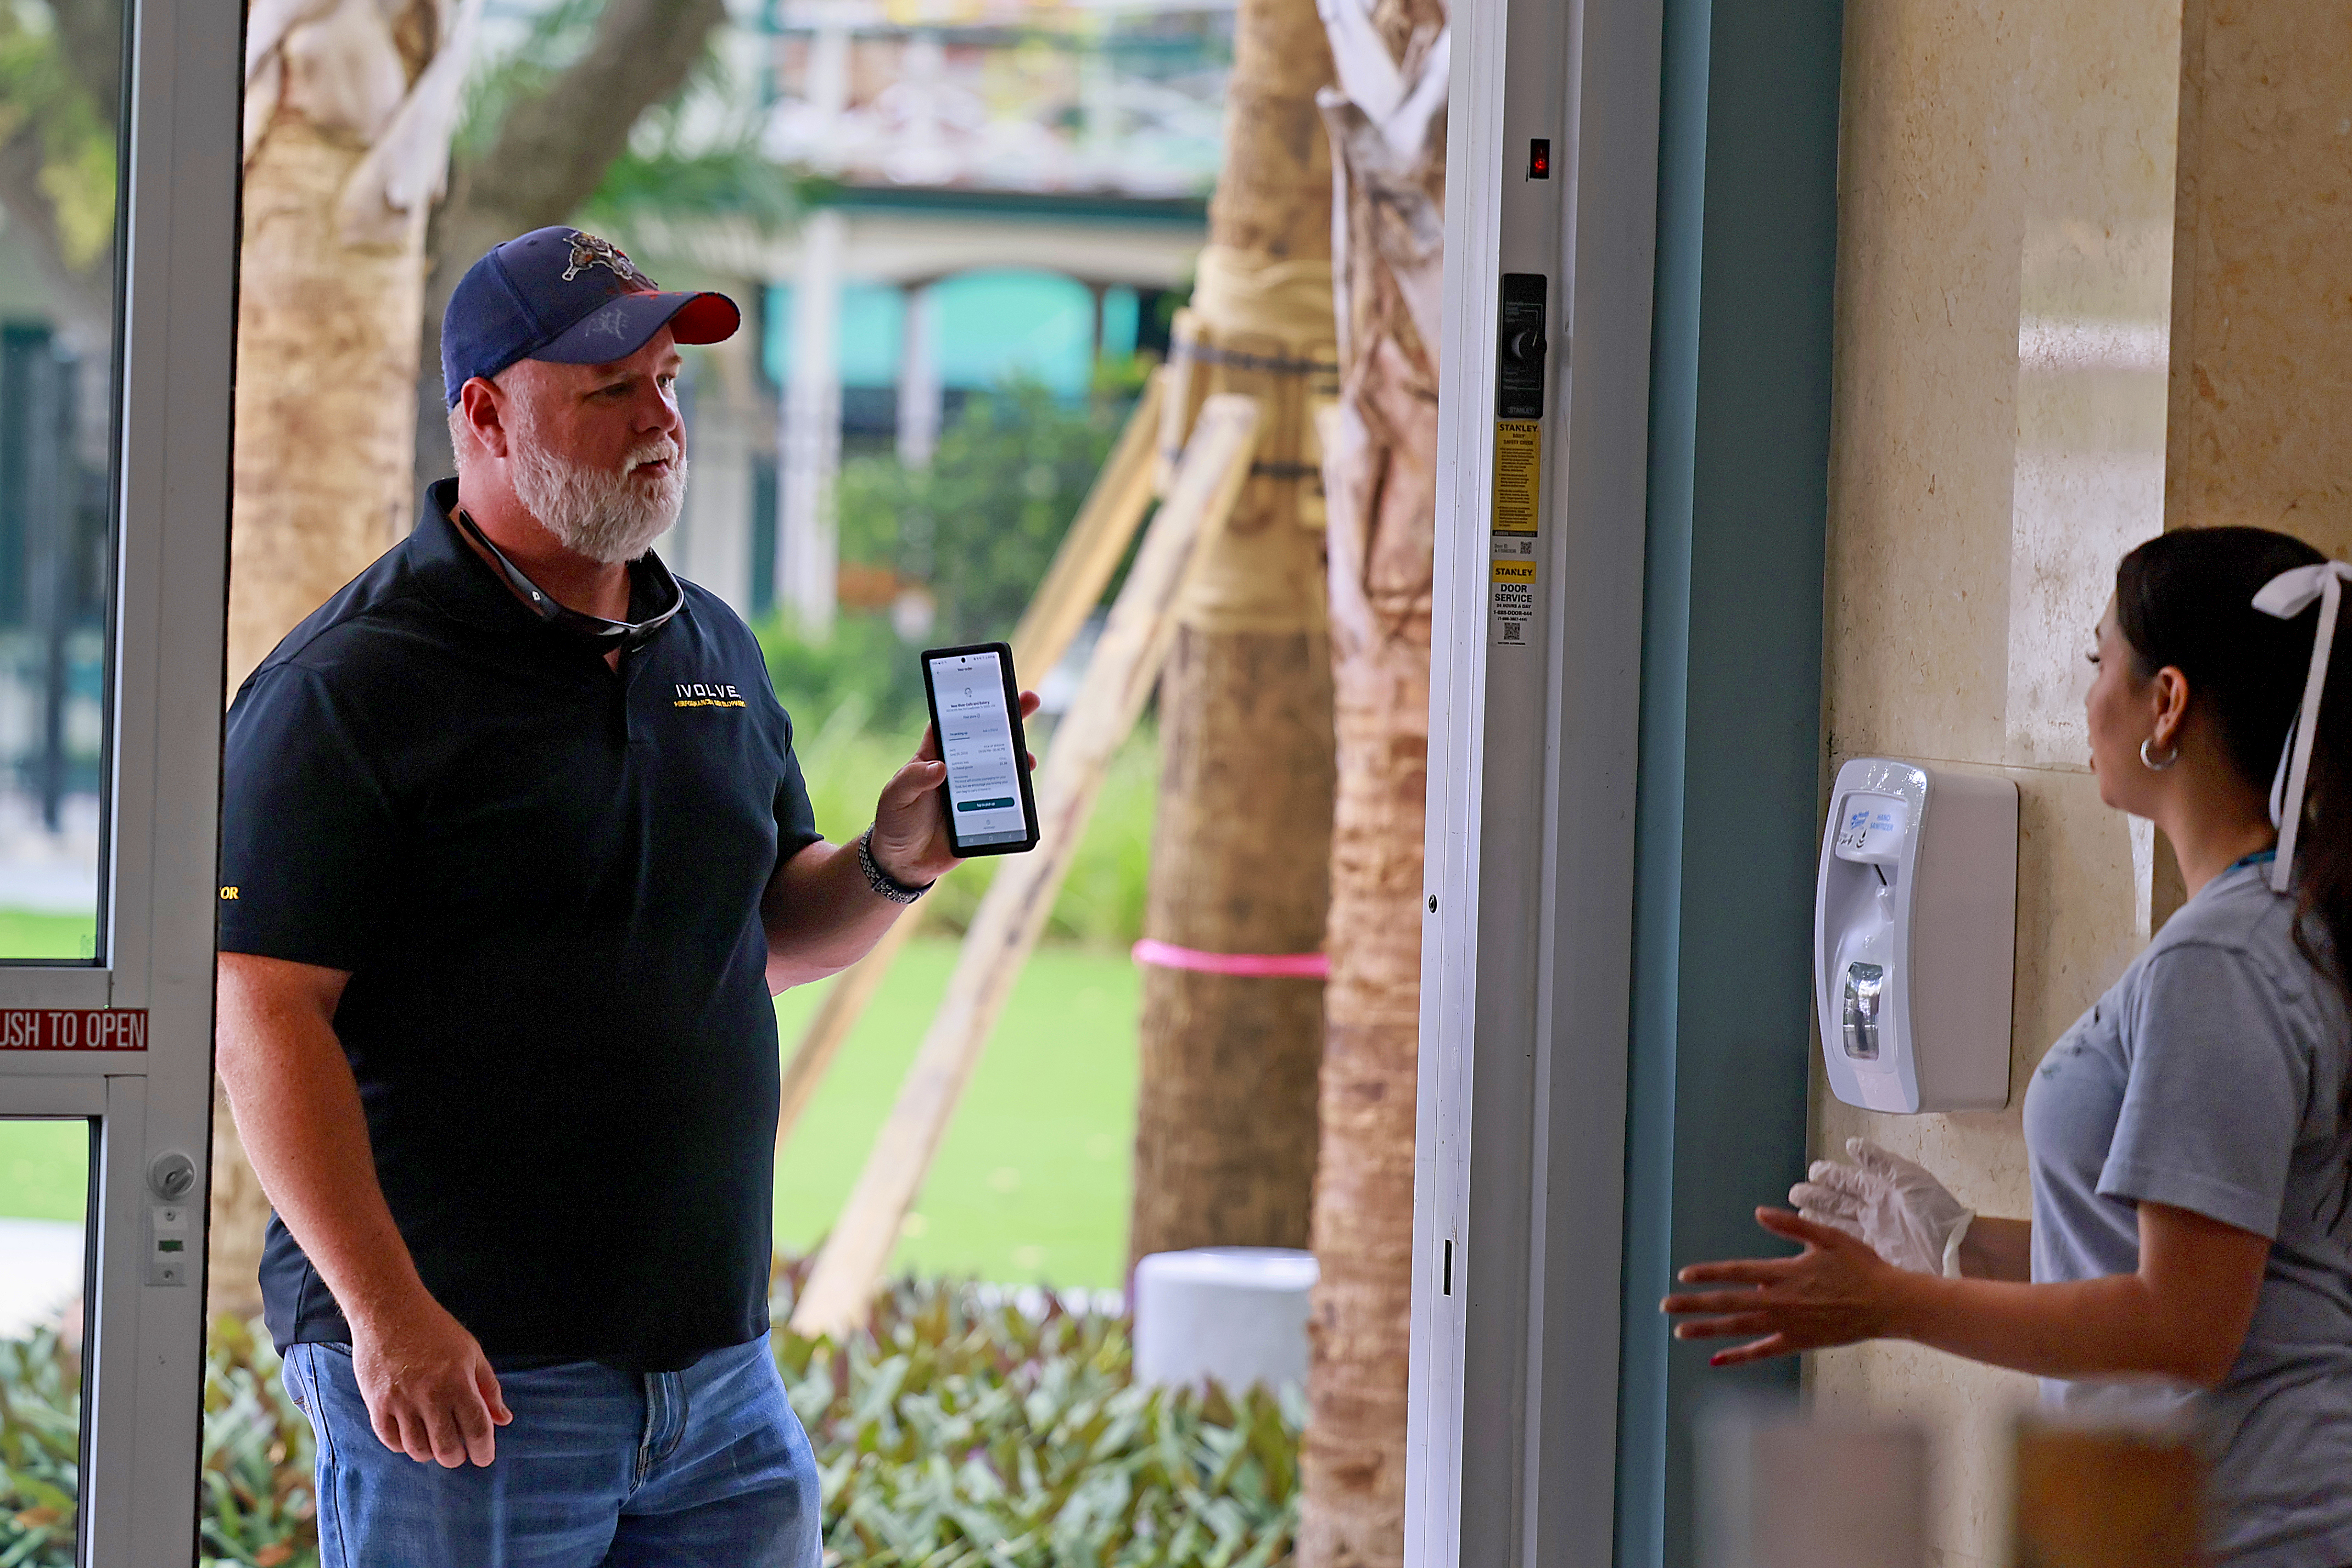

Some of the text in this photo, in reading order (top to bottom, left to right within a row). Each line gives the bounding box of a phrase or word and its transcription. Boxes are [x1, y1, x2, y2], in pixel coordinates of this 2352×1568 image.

[1499, 424, 1537, 432] STANLEY
[1496, 568, 1532, 576] STANLEY
[1500, 584, 1527, 593] DOOR
[1495, 593, 1532, 603] SERVICE
[675, 684, 742, 698] IVOLVE
[219, 886, 239, 900] OR
[48, 1012, 77, 1048] TO
[86, 1012, 145, 1048] OPEN
